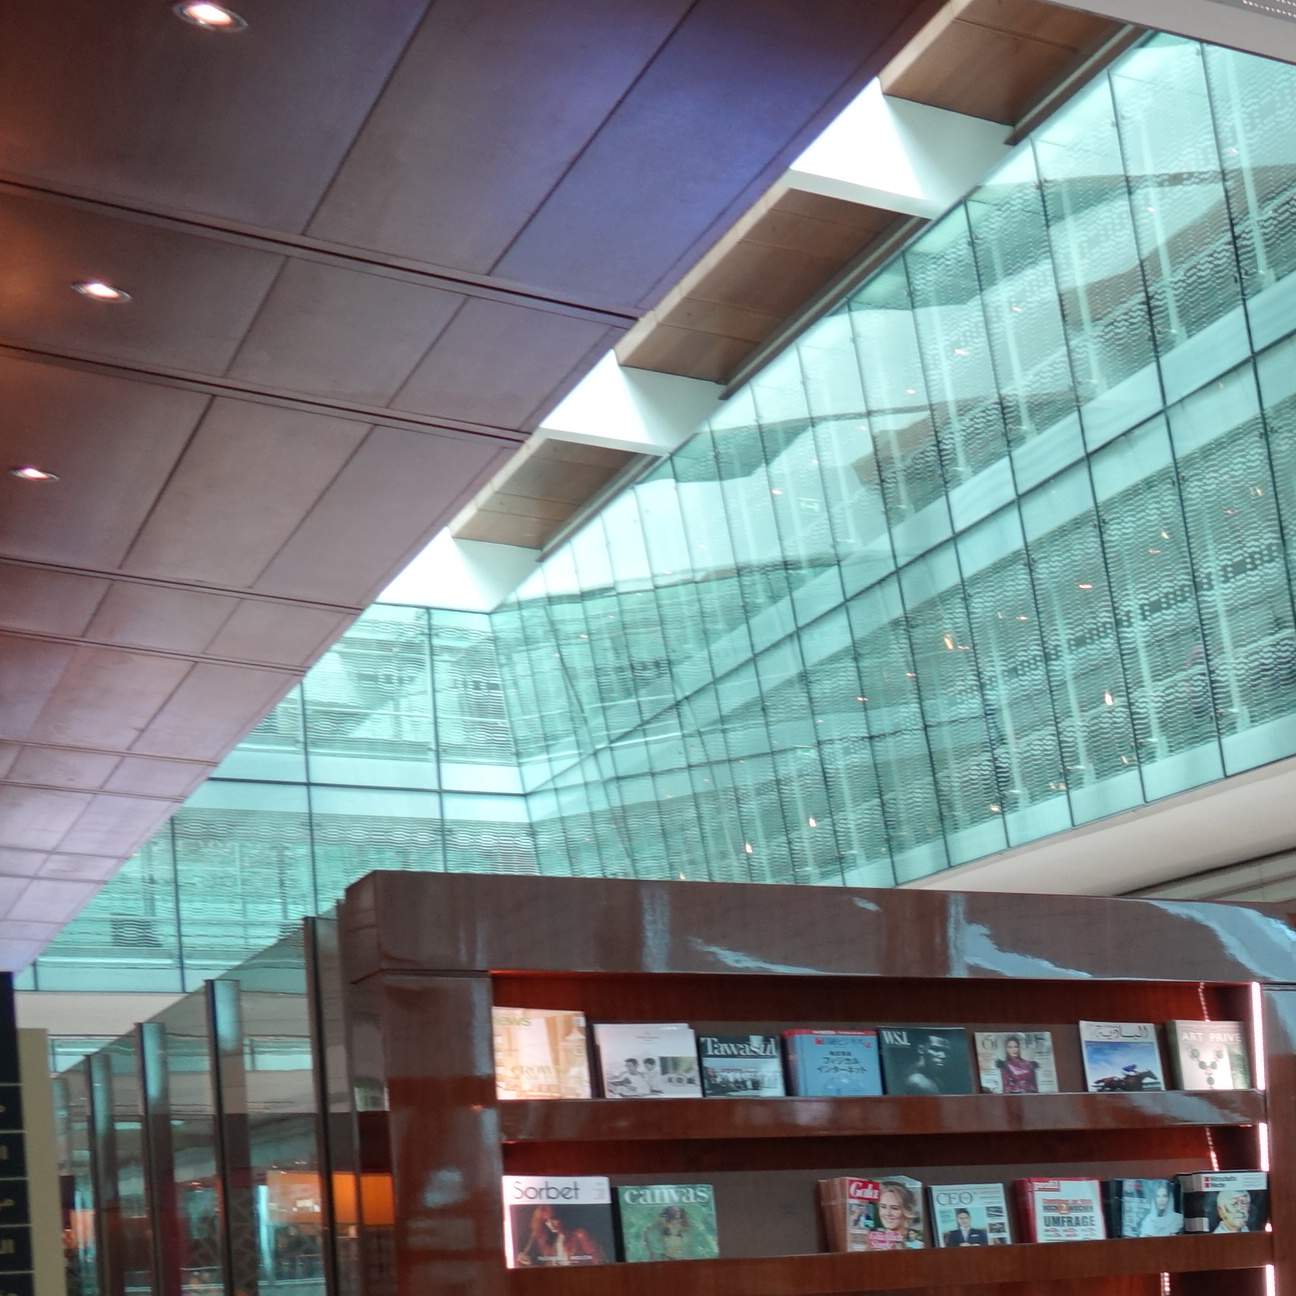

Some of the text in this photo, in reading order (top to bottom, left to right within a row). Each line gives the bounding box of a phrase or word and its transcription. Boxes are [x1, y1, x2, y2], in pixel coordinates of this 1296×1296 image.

[1181, 1032, 1203, 1042] ART
[700, 1036, 777, 1056] Tawasul
[513, 1181, 580, 1200] Sorbet
[624, 1186, 710, 1205] canvas
[849, 1182, 880, 1200] Gala
[936, 1191, 973, 1206] CEO
[1060, 1203, 1067, 1214] 2
[1043, 1216, 1096, 1227] UMFRAGE
